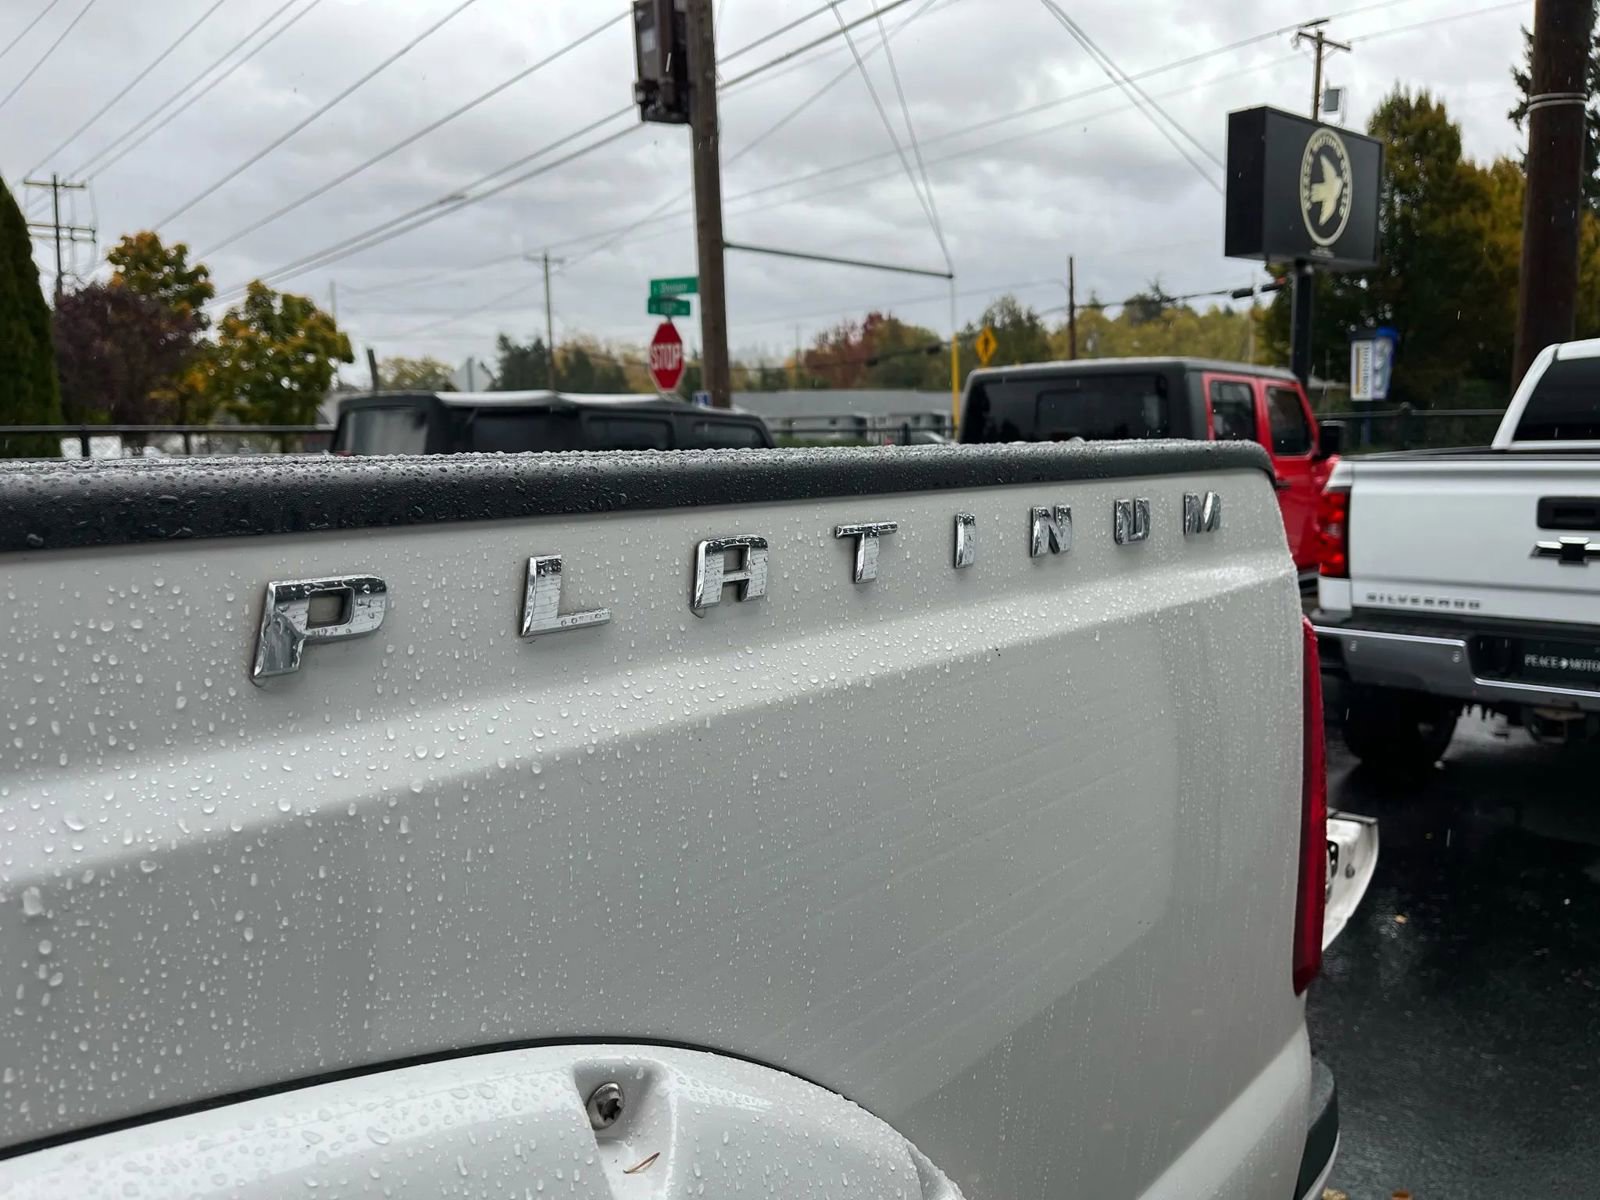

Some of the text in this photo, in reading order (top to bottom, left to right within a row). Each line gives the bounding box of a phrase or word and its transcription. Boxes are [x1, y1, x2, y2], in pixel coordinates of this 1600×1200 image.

[651, 343, 682, 371] STOP
[253, 492, 1222, 677] PLATINUM
[1366, 591, 1481, 610] SILVERADO
[1524, 653, 1560, 669] PEACE
